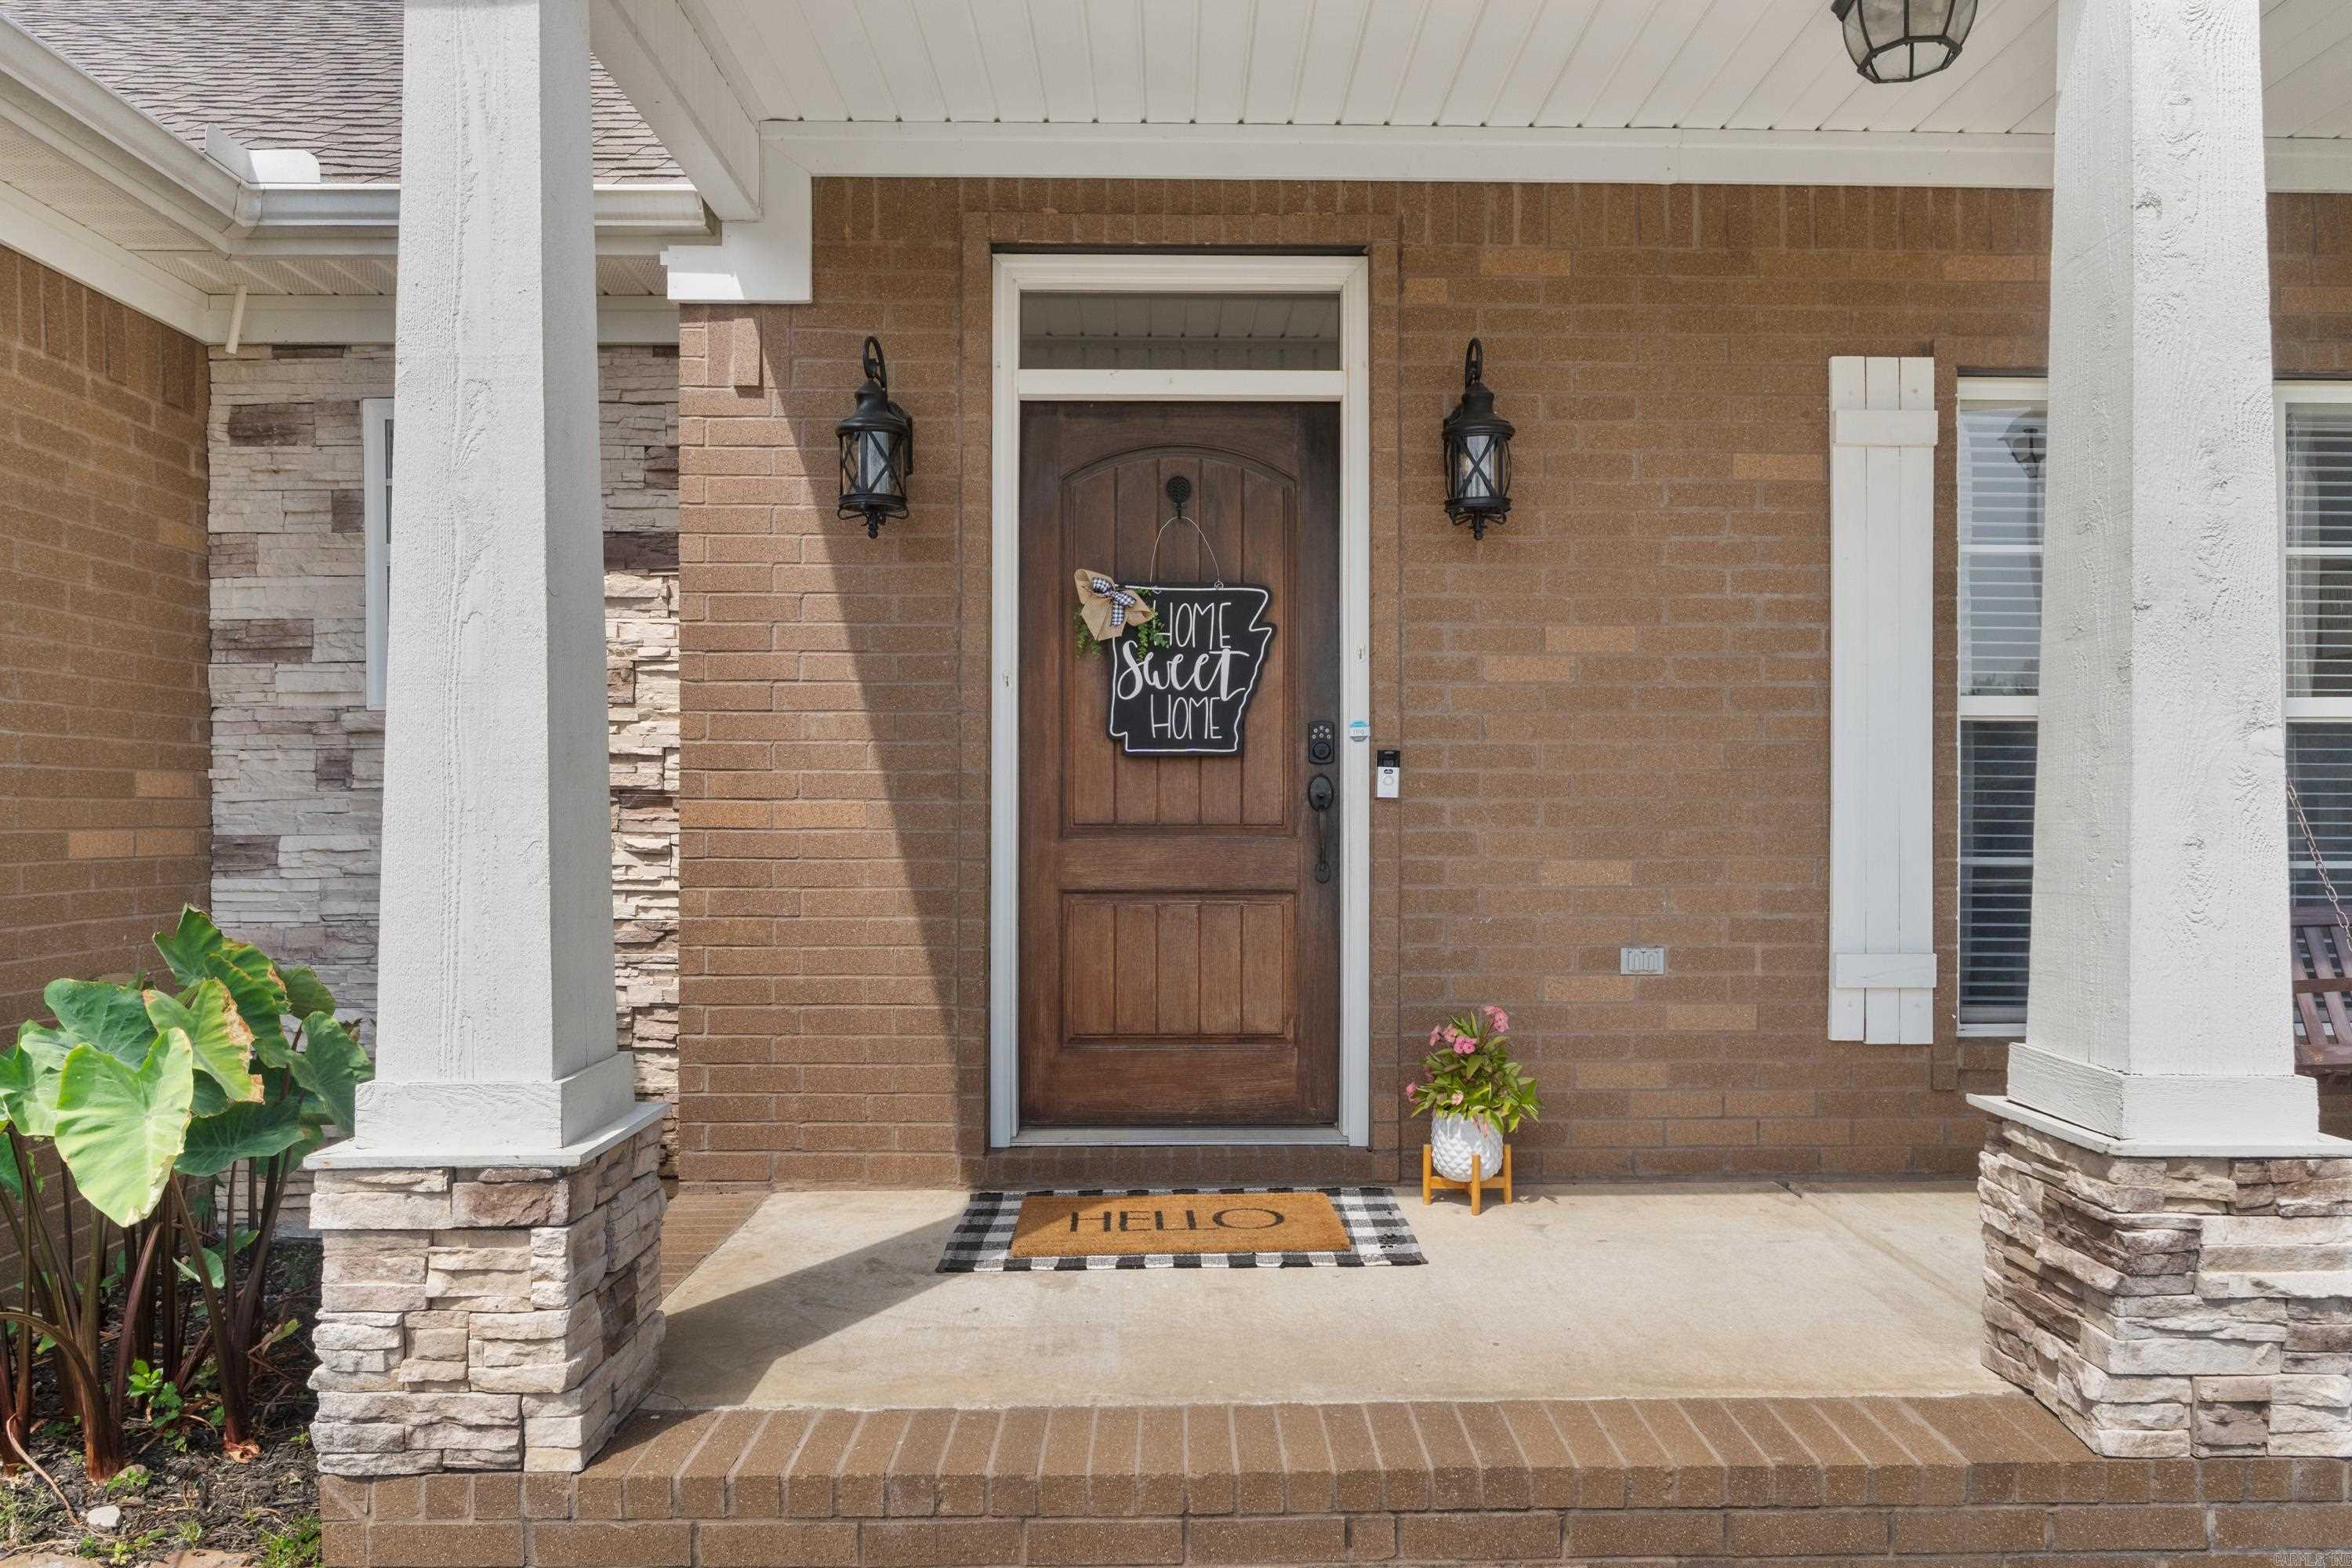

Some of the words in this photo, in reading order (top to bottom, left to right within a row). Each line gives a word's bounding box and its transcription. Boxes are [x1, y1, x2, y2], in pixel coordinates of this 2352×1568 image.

[1152, 600, 1232, 649] HOME
[1150, 694, 1222, 739] HOME
[1069, 1207, 1285, 1232] HELLO
